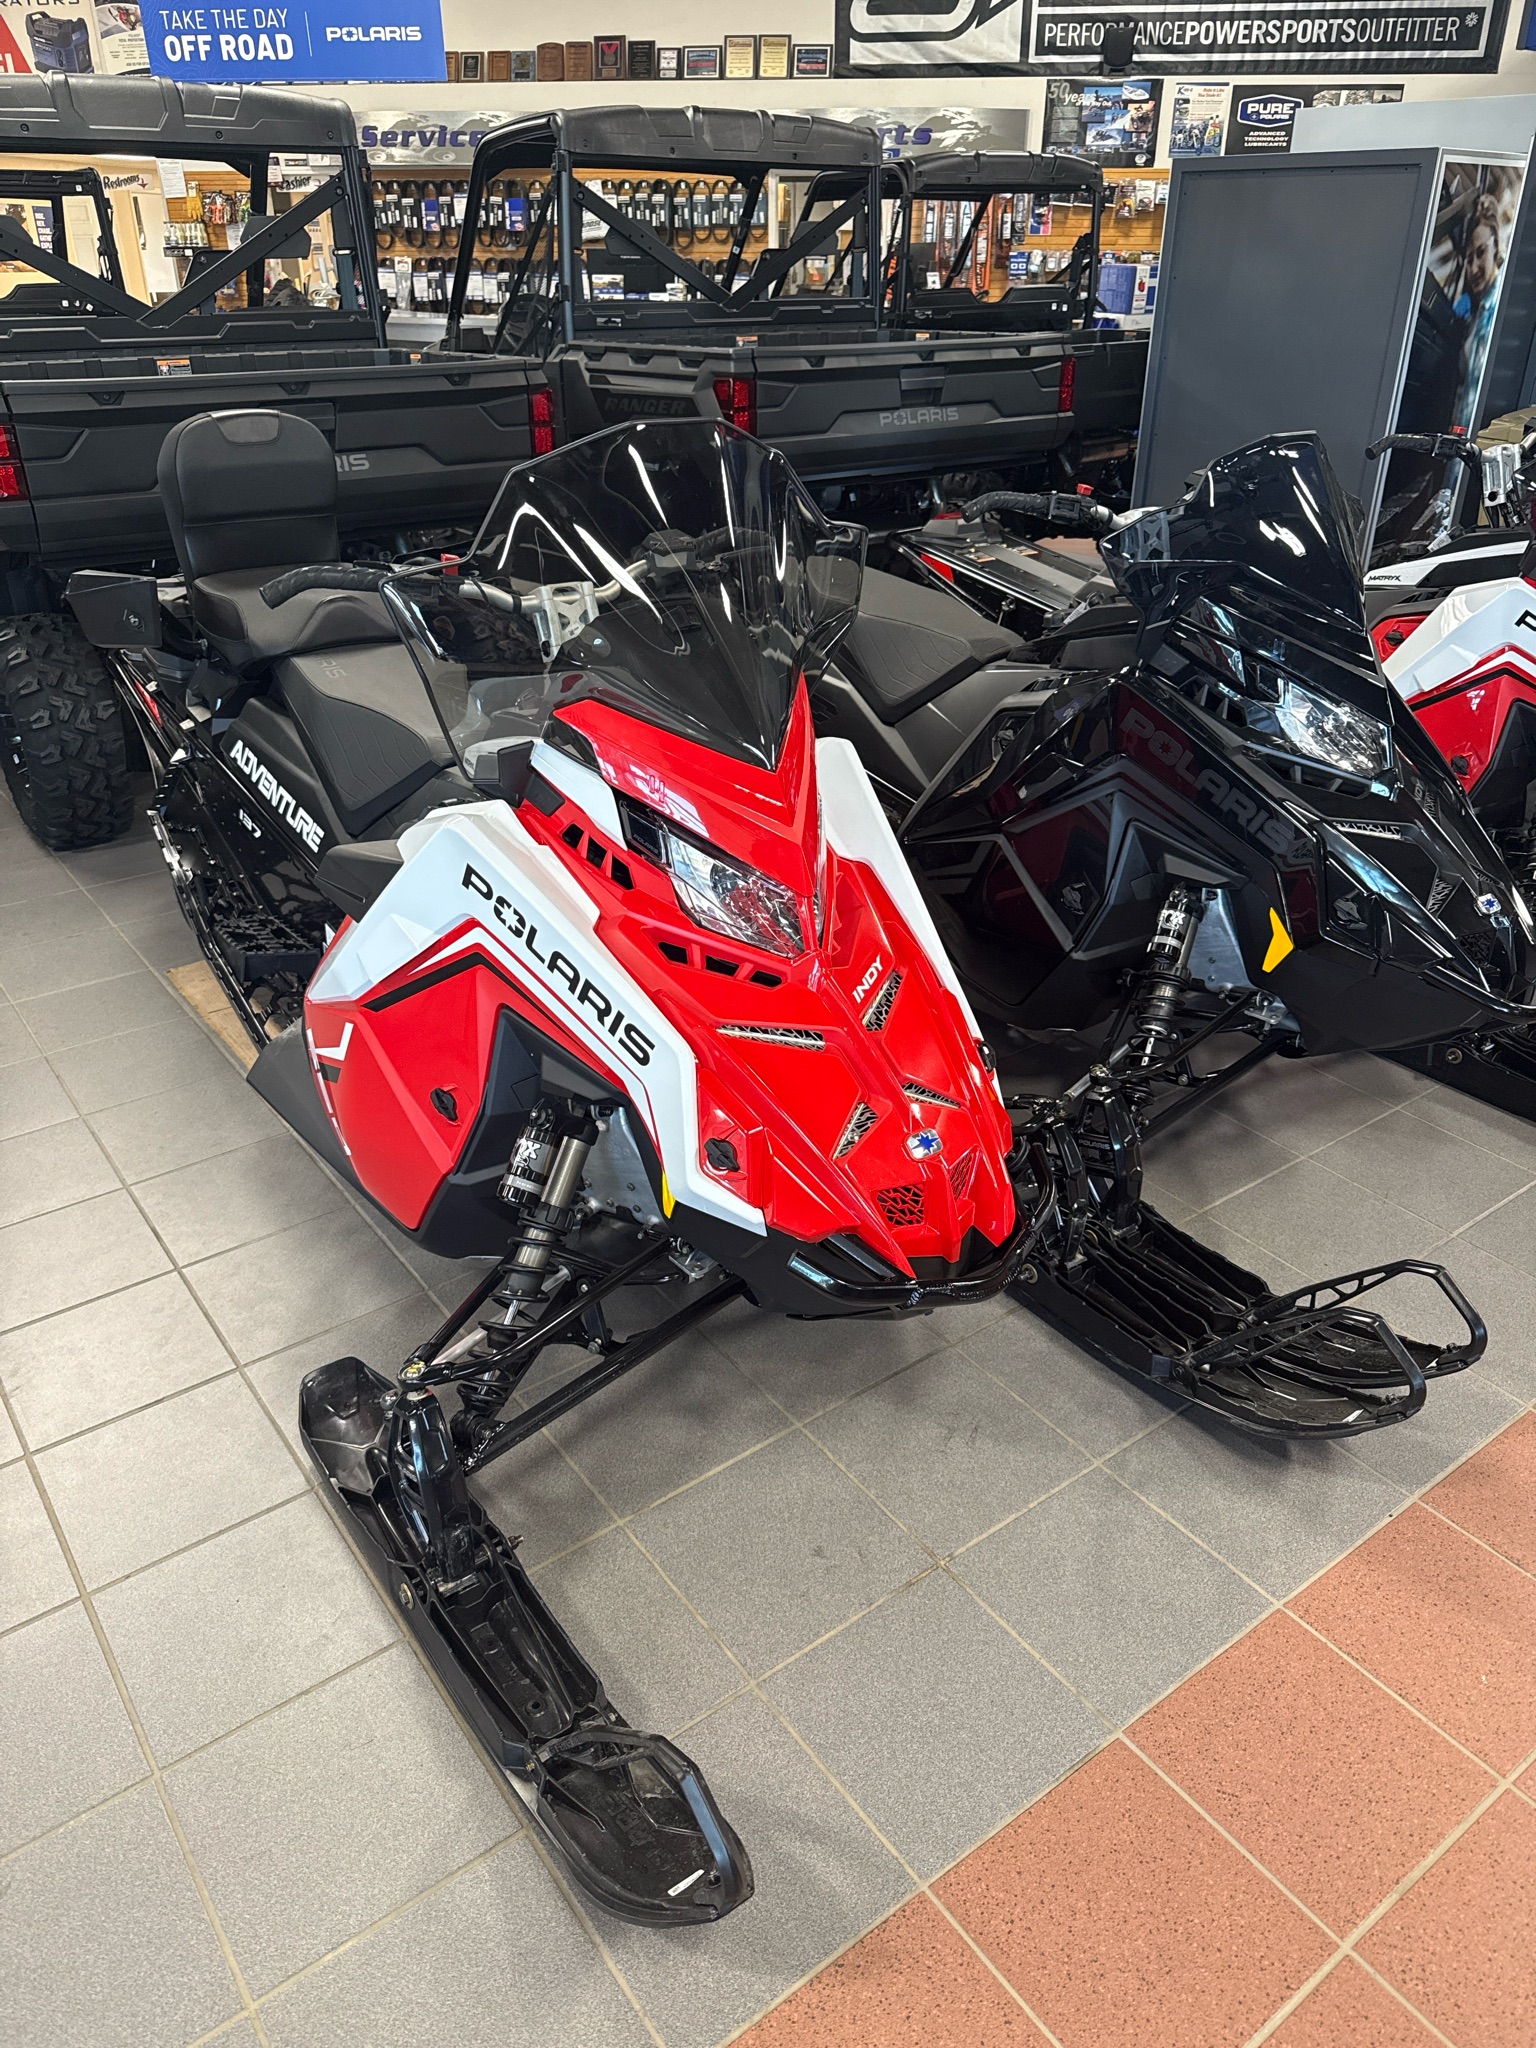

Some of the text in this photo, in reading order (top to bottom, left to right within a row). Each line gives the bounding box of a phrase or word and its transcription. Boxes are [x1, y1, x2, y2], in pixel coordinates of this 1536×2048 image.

[159, 8, 288, 30] TAKE THE DAY
[325, 26, 423, 42] POLARIS
[1044, 17, 1461, 47] PERFOANCEPOWERSPORTSOUTFITTER
[164, 33, 294, 62] OFF ROAD
[1048, 83, 1070, 98] 50
[1063, 93, 1097, 105] years
[1247, 103, 1294, 114] PURE
[103, 174, 140, 190] Restrooms
[603, 397, 687, 415] RANGER
[880, 407, 958, 427] POLARIS
[1119, 707, 1296, 854] POLARIS
[229, 739, 325, 854] ADVENTURE
[239, 808, 262, 839] 137
[461, 862, 656, 1067] POLARIS
[852, 953, 883, 1004] INDY
